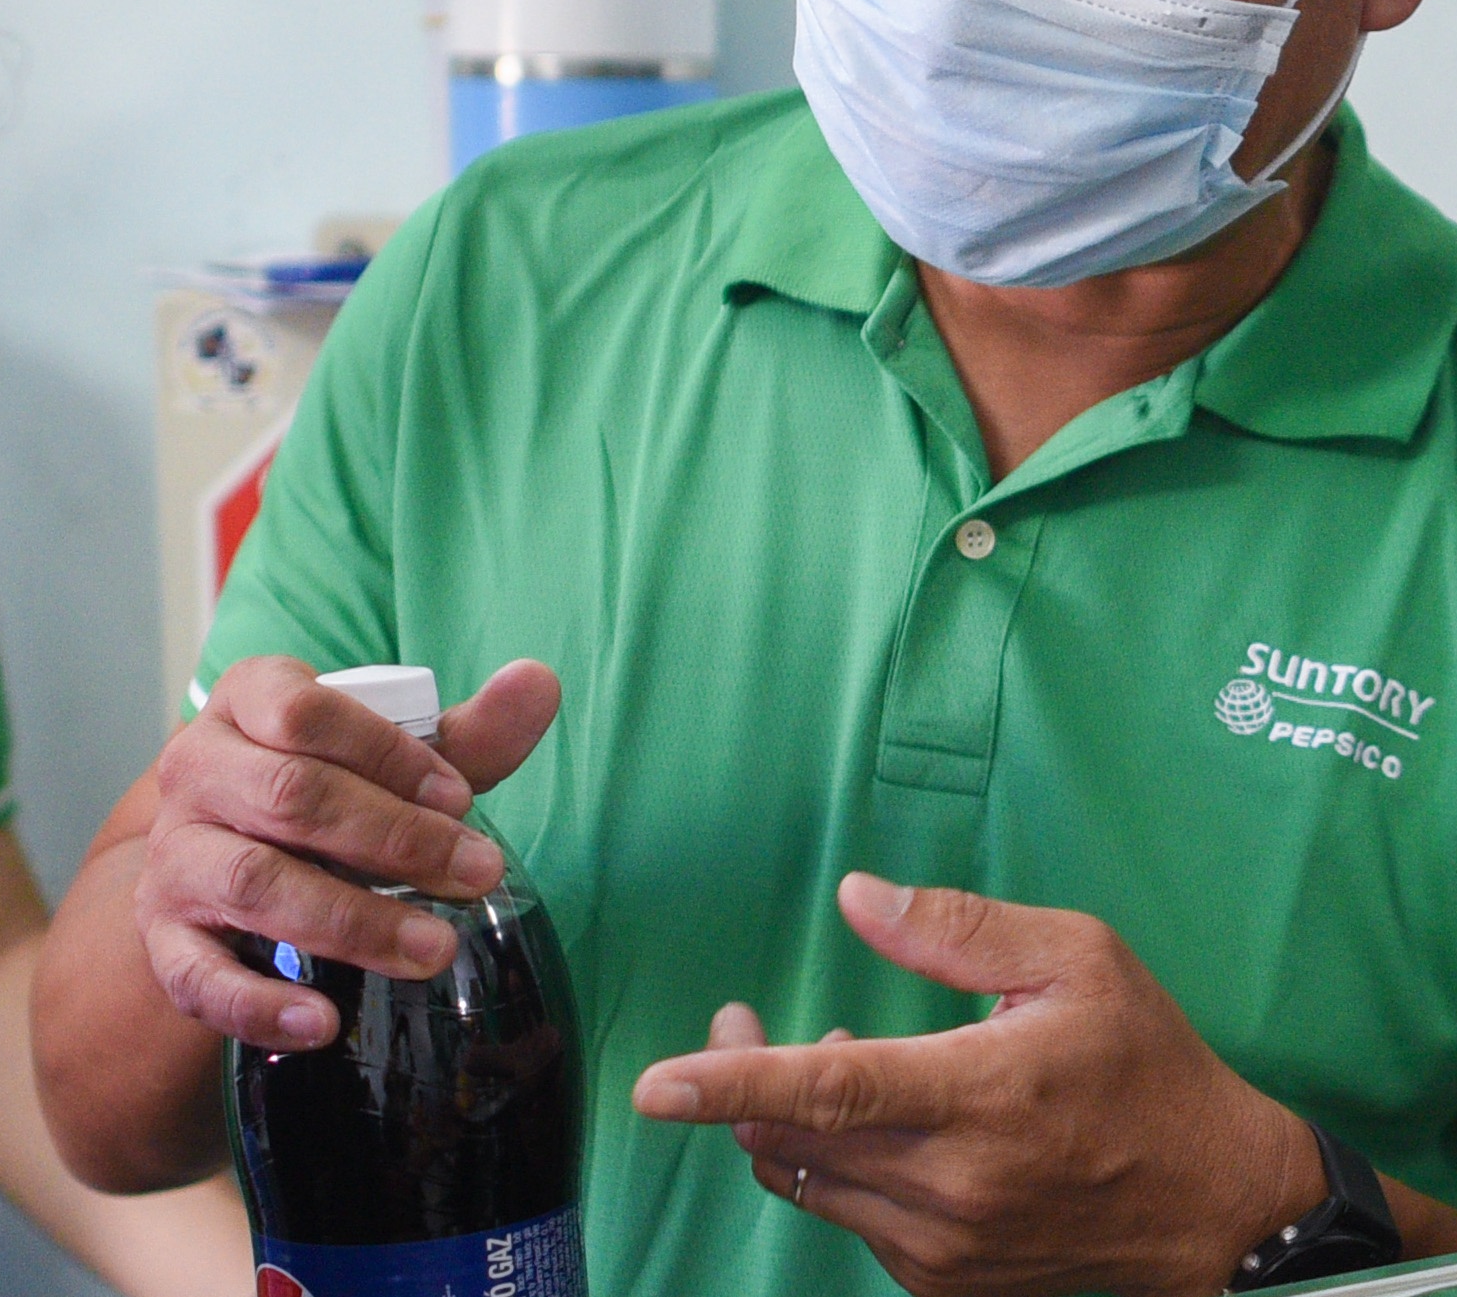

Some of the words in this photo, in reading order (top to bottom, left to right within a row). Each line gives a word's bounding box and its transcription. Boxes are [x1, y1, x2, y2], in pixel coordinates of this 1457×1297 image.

[1239, 641, 1437, 726] SUNTORY
[1268, 721, 1403, 780] PEPSICO
[486, 1232, 515, 1280] GAZ
